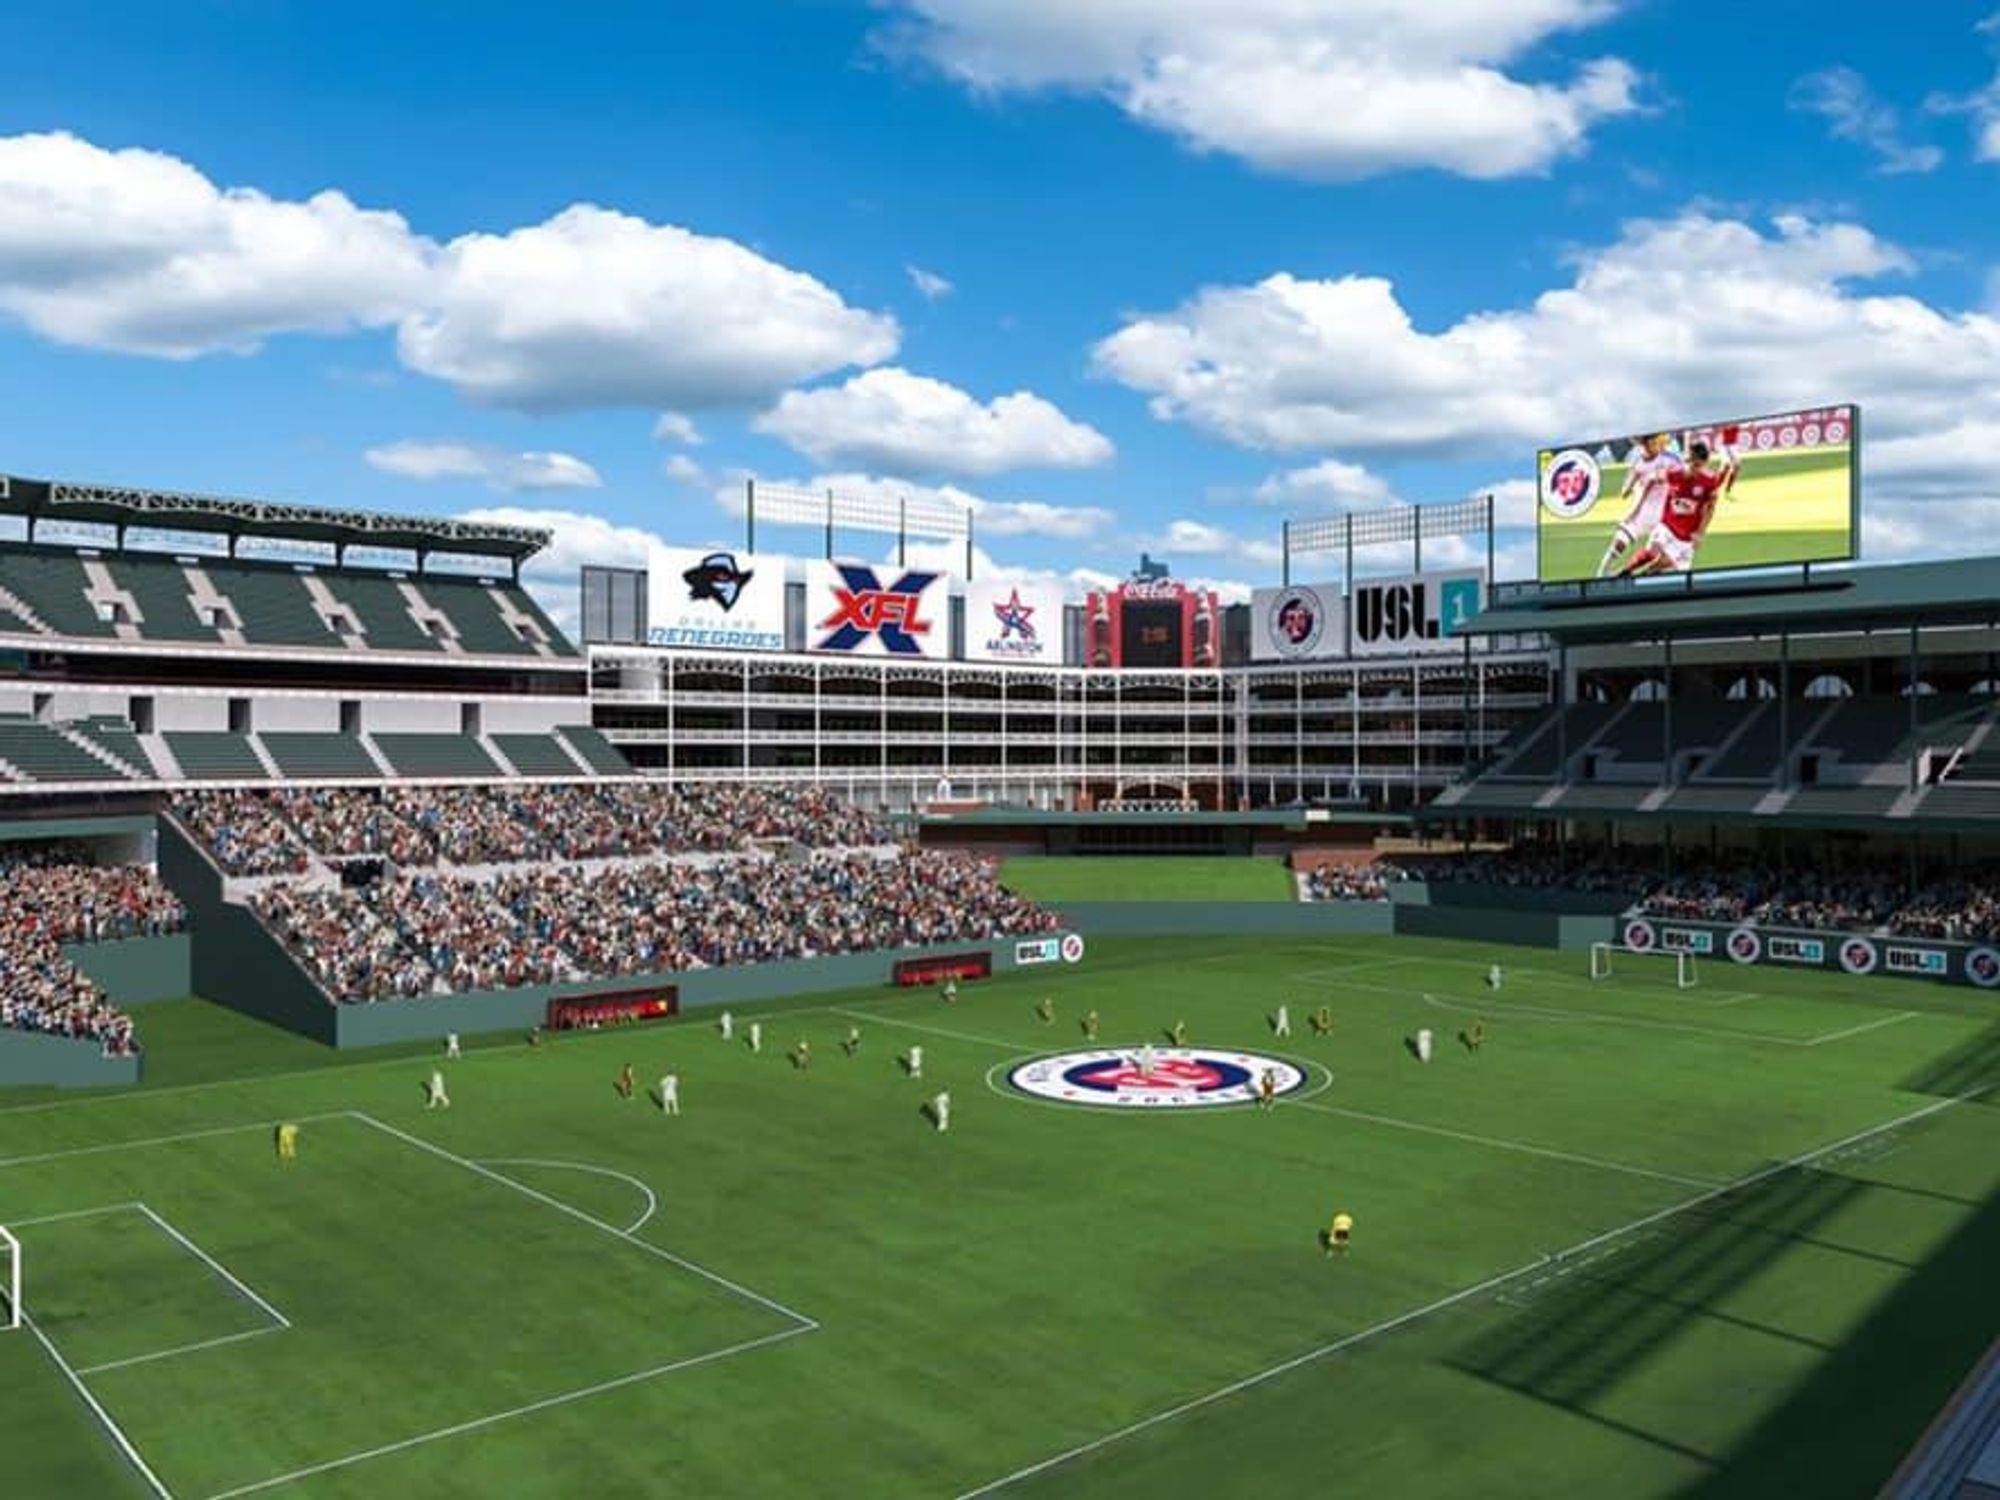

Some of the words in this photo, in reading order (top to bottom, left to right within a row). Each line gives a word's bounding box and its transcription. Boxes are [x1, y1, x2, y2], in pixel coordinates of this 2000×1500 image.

[823, 588, 931, 633] XFL
[1357, 583, 1439, 642] USL
[1451, 593, 1470, 625] 1
